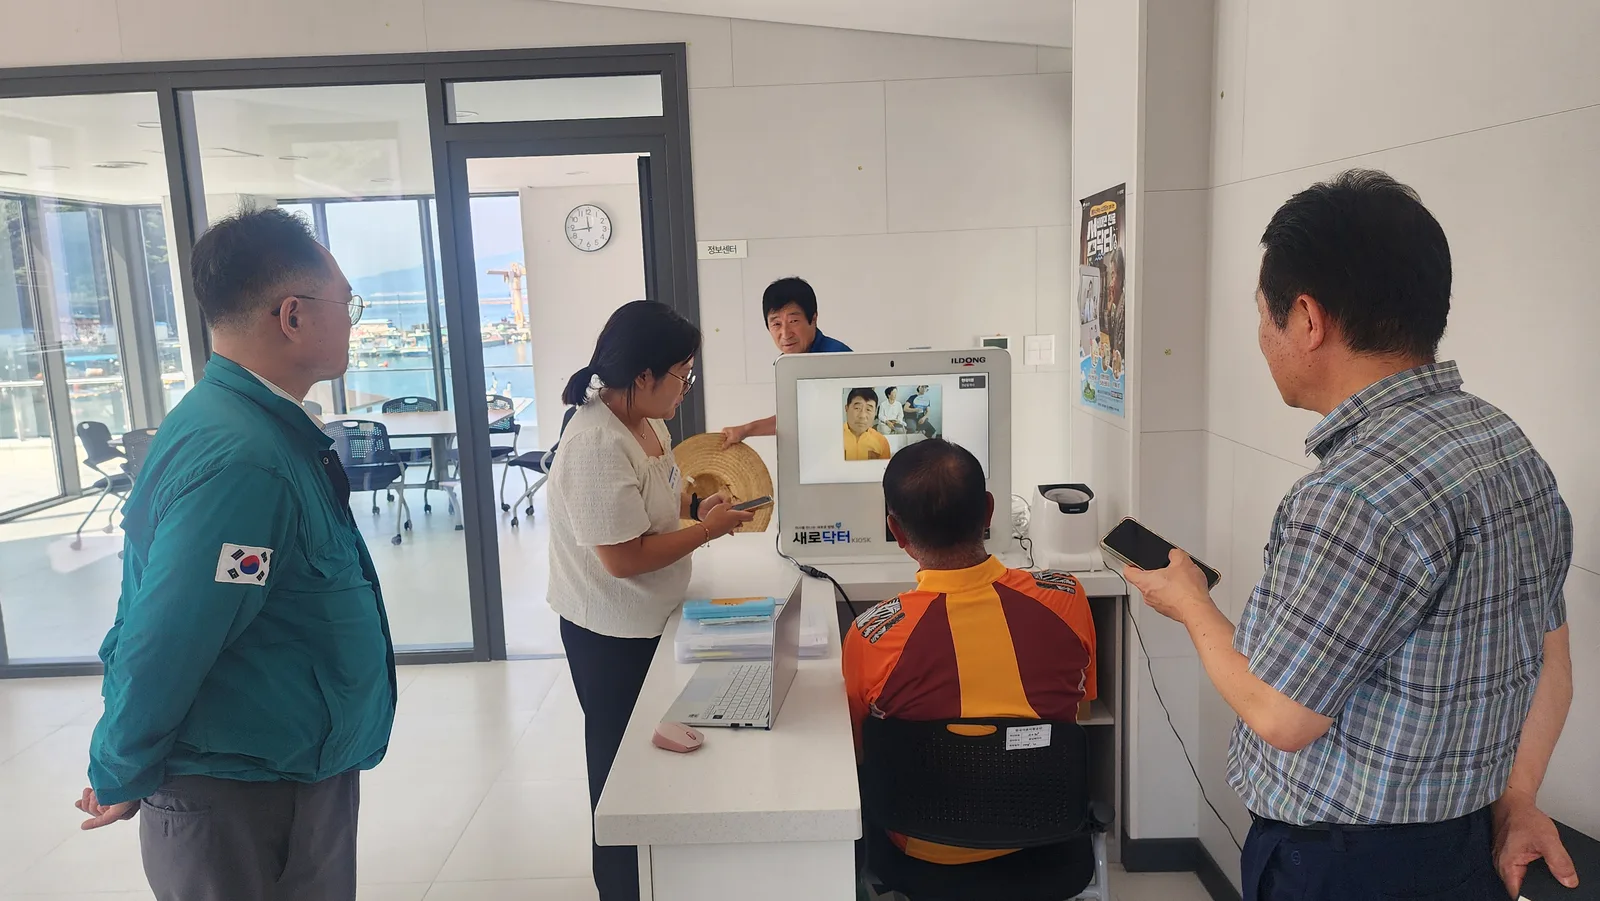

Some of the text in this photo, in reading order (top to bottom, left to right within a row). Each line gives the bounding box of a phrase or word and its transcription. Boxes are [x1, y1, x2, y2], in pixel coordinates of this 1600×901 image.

[707, 245, 737, 255] 정보센터
[951, 356, 986, 364] ILDONG
[793, 530, 850, 544] 새로닥터
